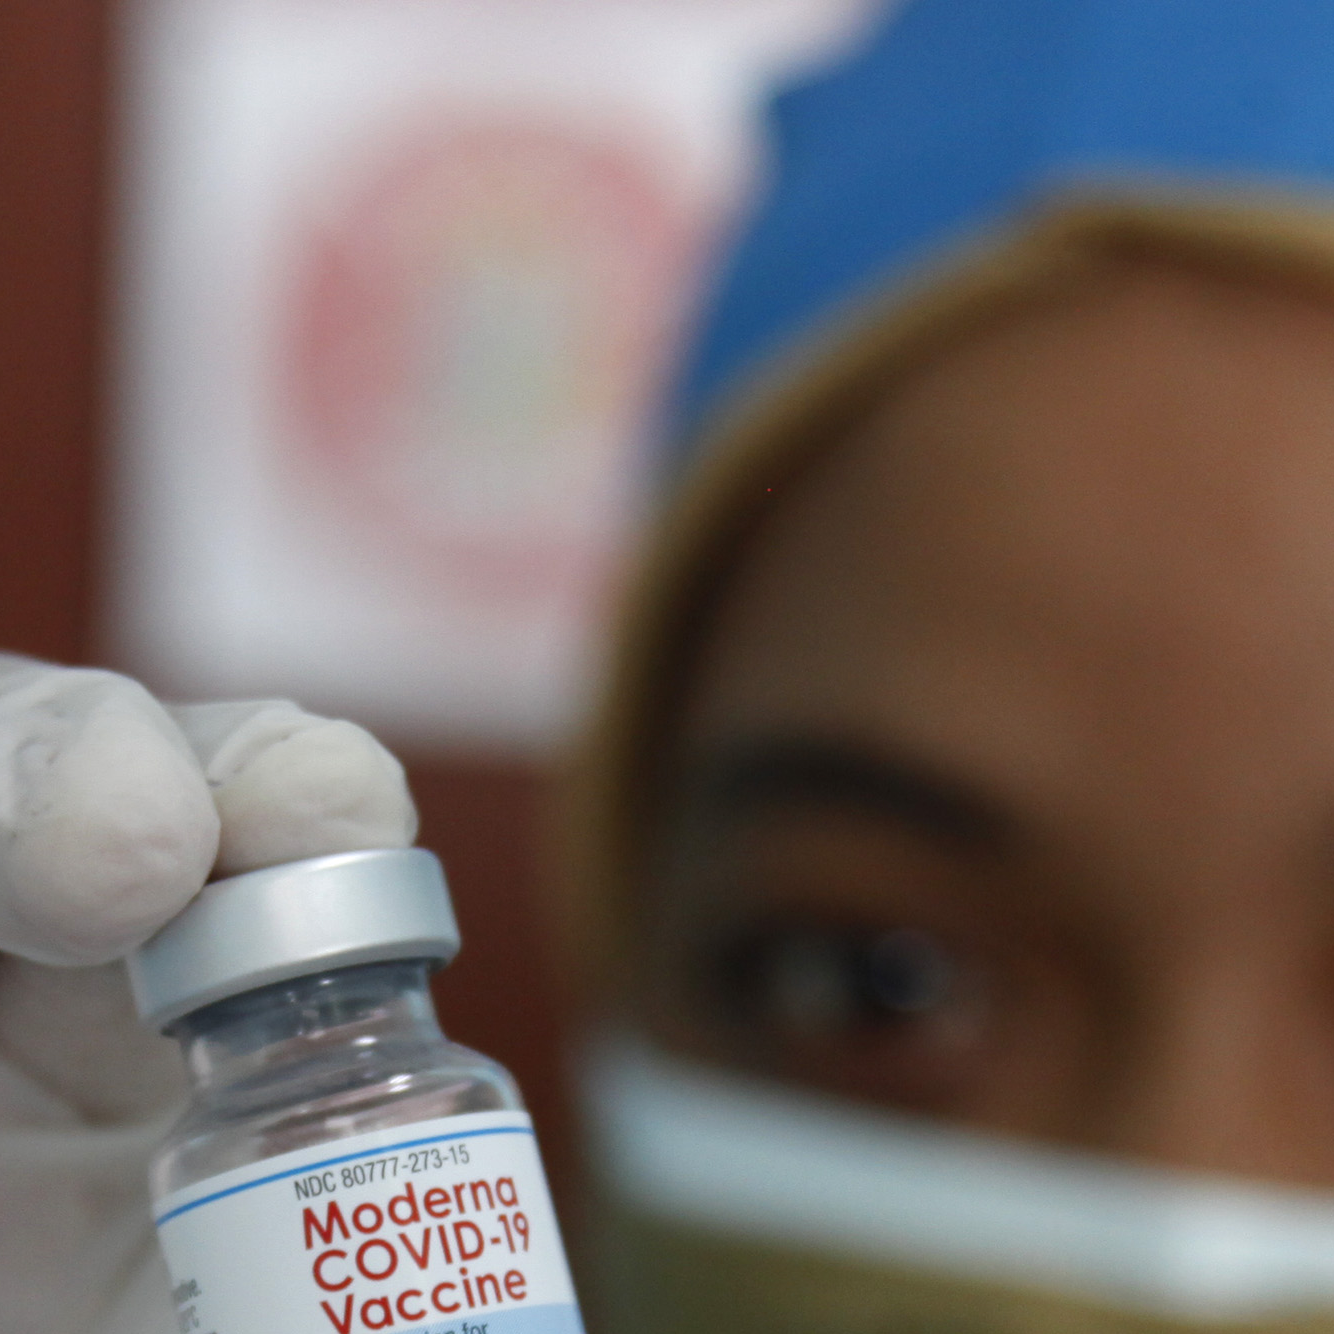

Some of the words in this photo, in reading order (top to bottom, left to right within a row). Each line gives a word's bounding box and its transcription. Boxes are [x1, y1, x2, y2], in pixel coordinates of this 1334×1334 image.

[294, 1171, 336, 1201] NDC
[341, 1144, 470, 1188] 80777-273-15
[302, 1177, 518, 1250] Moderna
[312, 1211, 530, 1292] COVID-19
